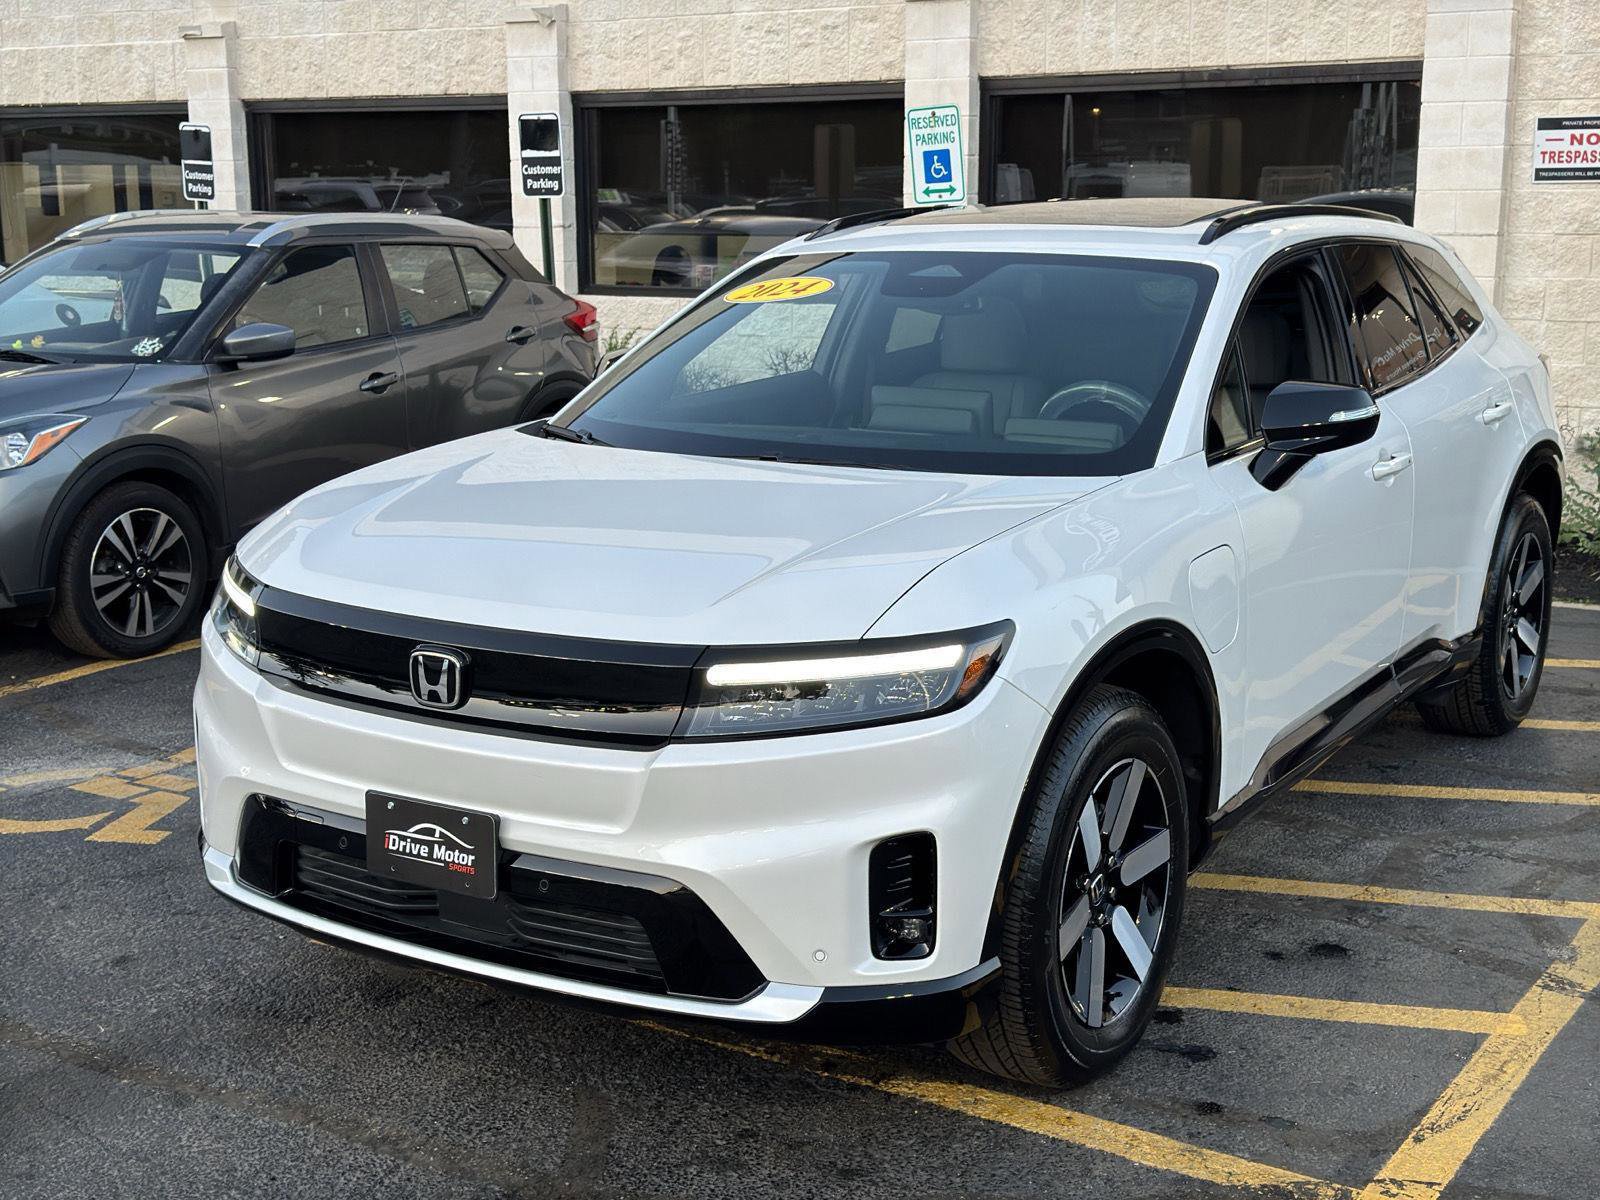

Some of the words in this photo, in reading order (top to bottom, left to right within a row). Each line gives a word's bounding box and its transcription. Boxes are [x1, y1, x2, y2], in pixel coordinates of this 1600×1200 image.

[910, 114, 957, 130] RESERVED
[915, 131, 956, 146] PARKING
[1569, 133, 1600, 146] NO
[1540, 150, 1600, 164] TRESPAS
[185, 170, 214, 181] Customer
[522, 164, 562, 175] Customer
[188, 183, 212, 196] Parking
[526, 178, 559, 191] Parking
[733, 279, 823, 300] 2024
[384, 832, 429, 857] iDrive
[432, 843, 475, 867] Motor
[448, 863, 475, 875] SPORTS
